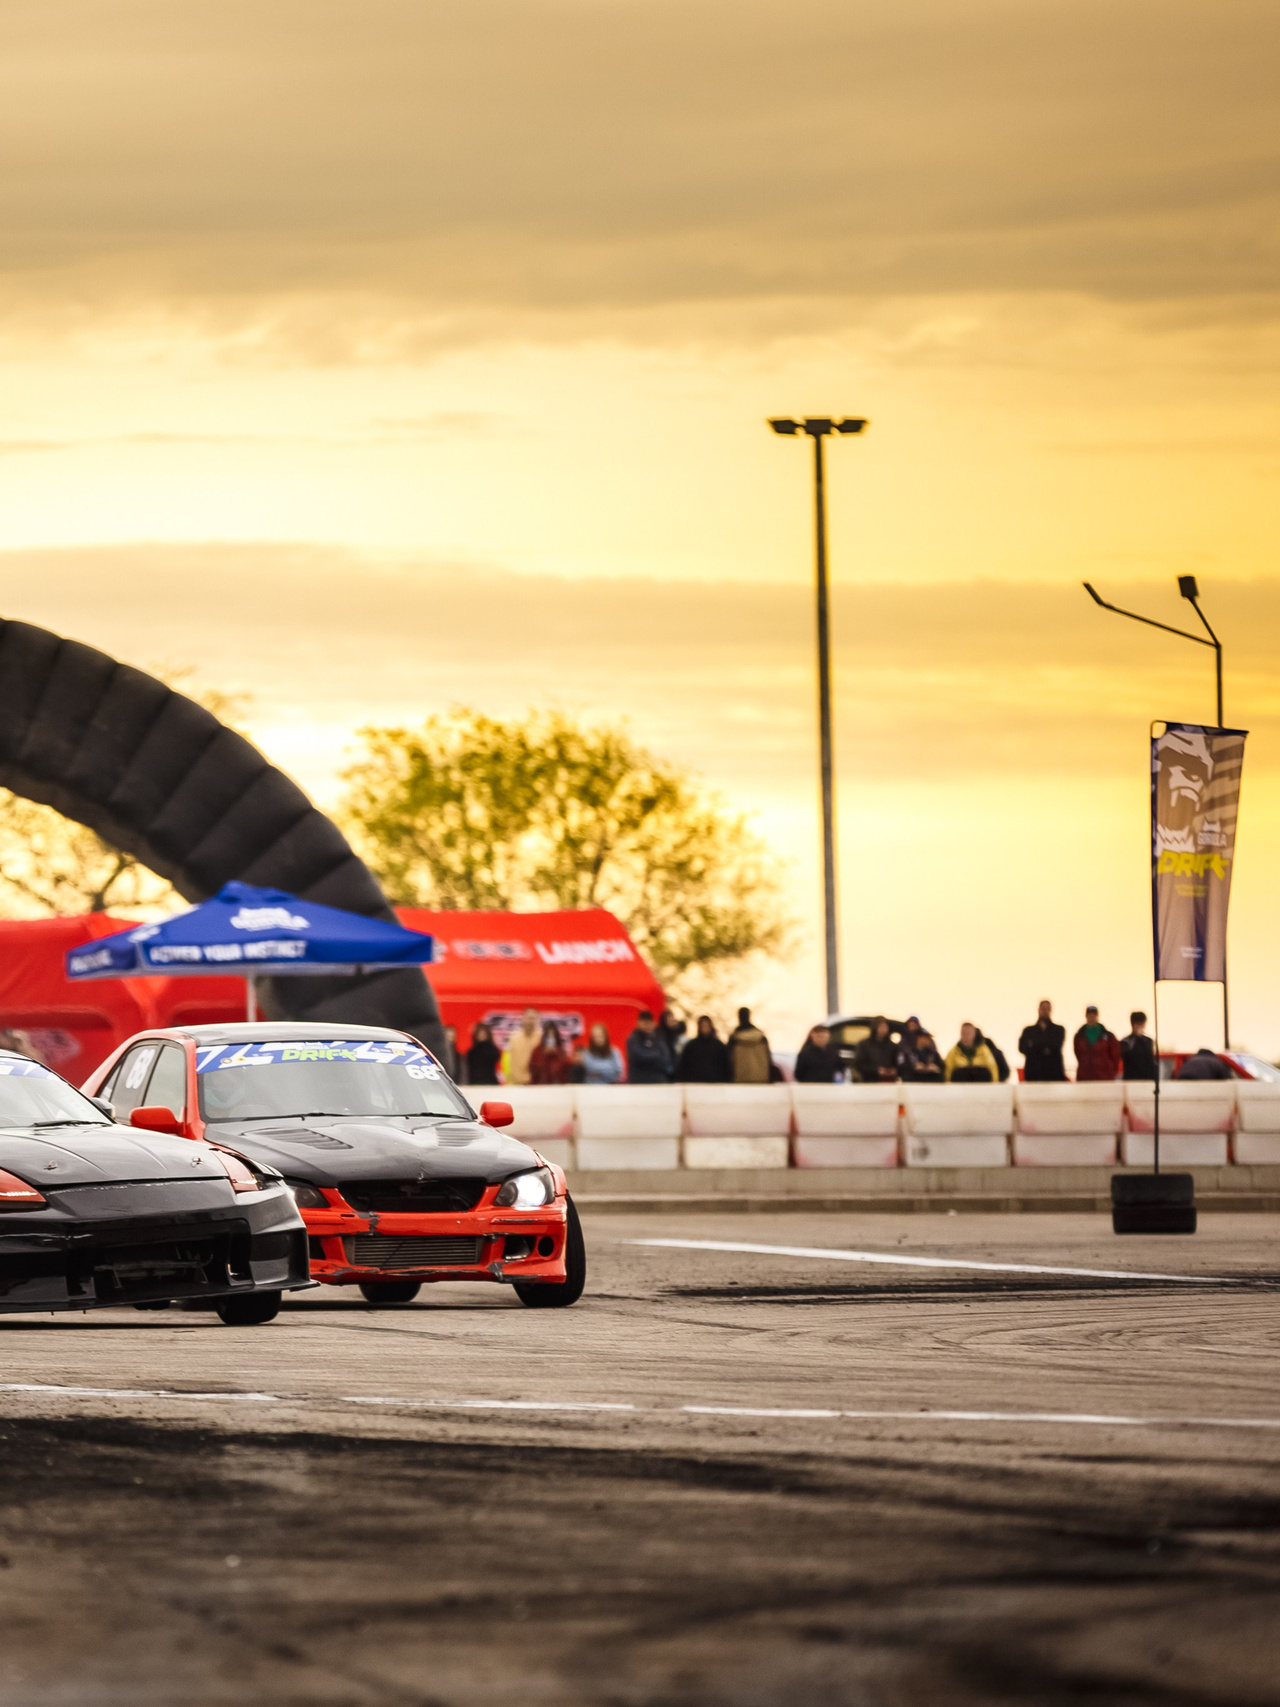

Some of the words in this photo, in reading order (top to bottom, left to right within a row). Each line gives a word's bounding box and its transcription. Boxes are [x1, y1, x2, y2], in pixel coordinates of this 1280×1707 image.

[243, 940, 307, 959] INSTINCT
[535, 939, 634, 963] LAUNCH
[405, 1065, 440, 1080] 68
